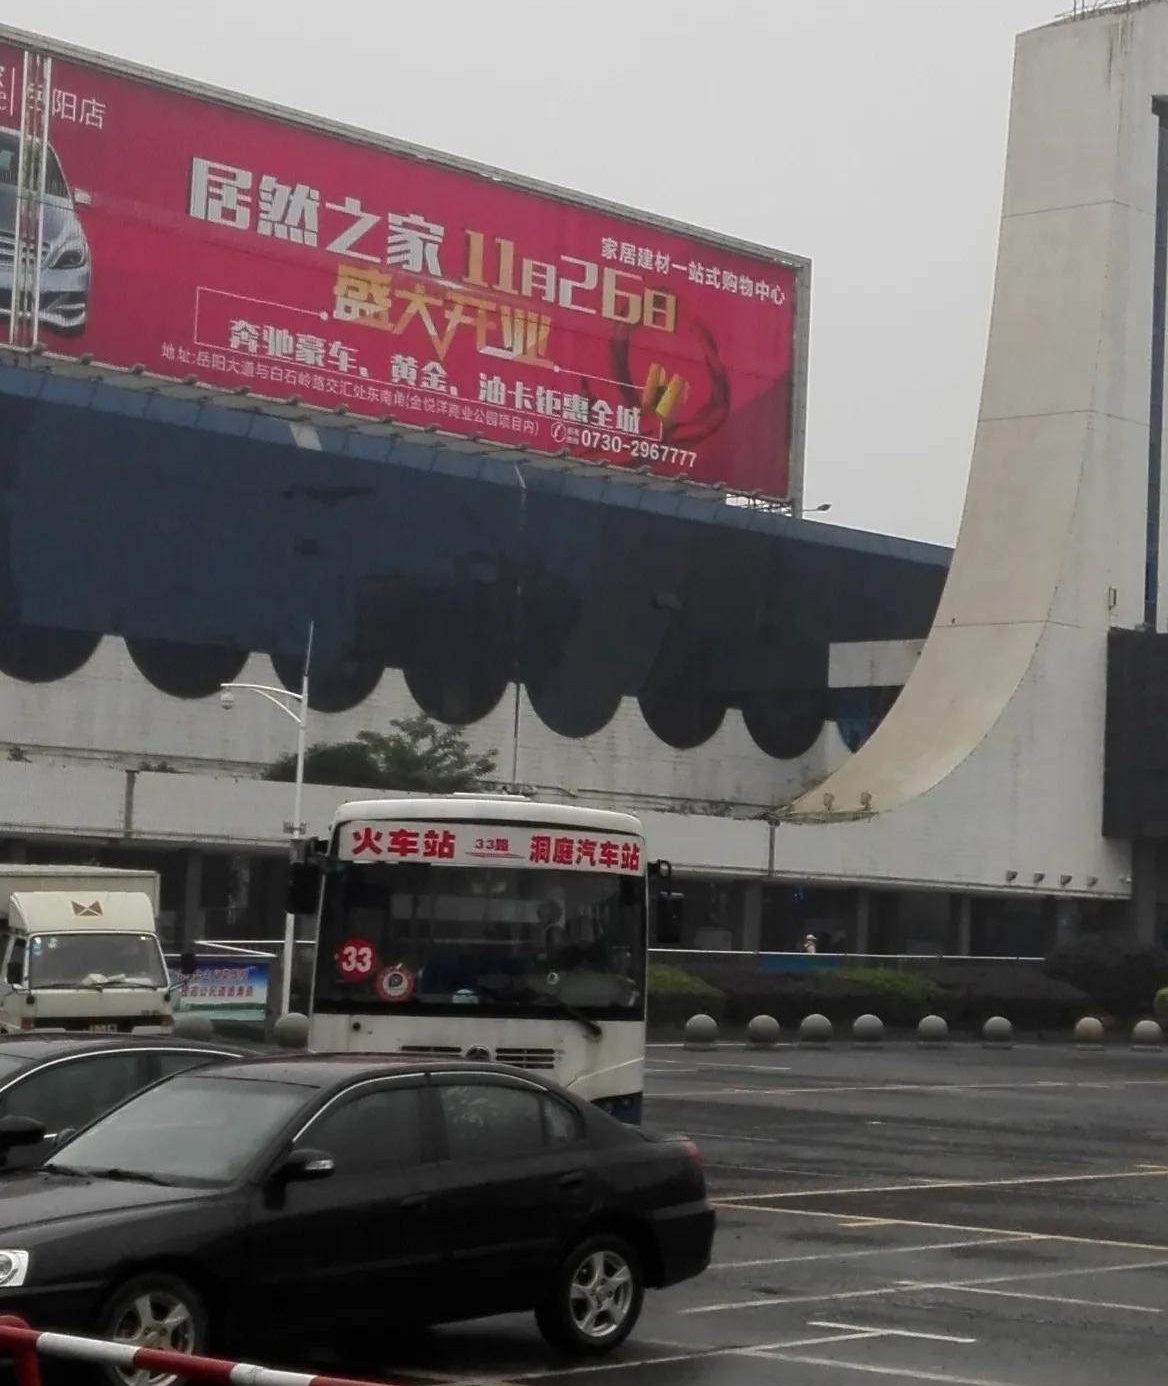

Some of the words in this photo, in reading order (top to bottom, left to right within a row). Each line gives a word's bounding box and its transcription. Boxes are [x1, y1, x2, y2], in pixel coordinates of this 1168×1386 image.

[189, 156, 445, 277] 居然之家
[460, 227, 678, 334] 11月26日
[600, 236, 786, 306] 家居建材一站式购物中心
[332, 263, 555, 371] 盛大开业
[581, 429, 698, 469] 0730-2967777
[352, 826, 457, 860] 火车站
[474, 837, 510, 852] 33路
[529, 834, 641, 872] 洞庭汽车站
[341, 945, 373, 973] 33
